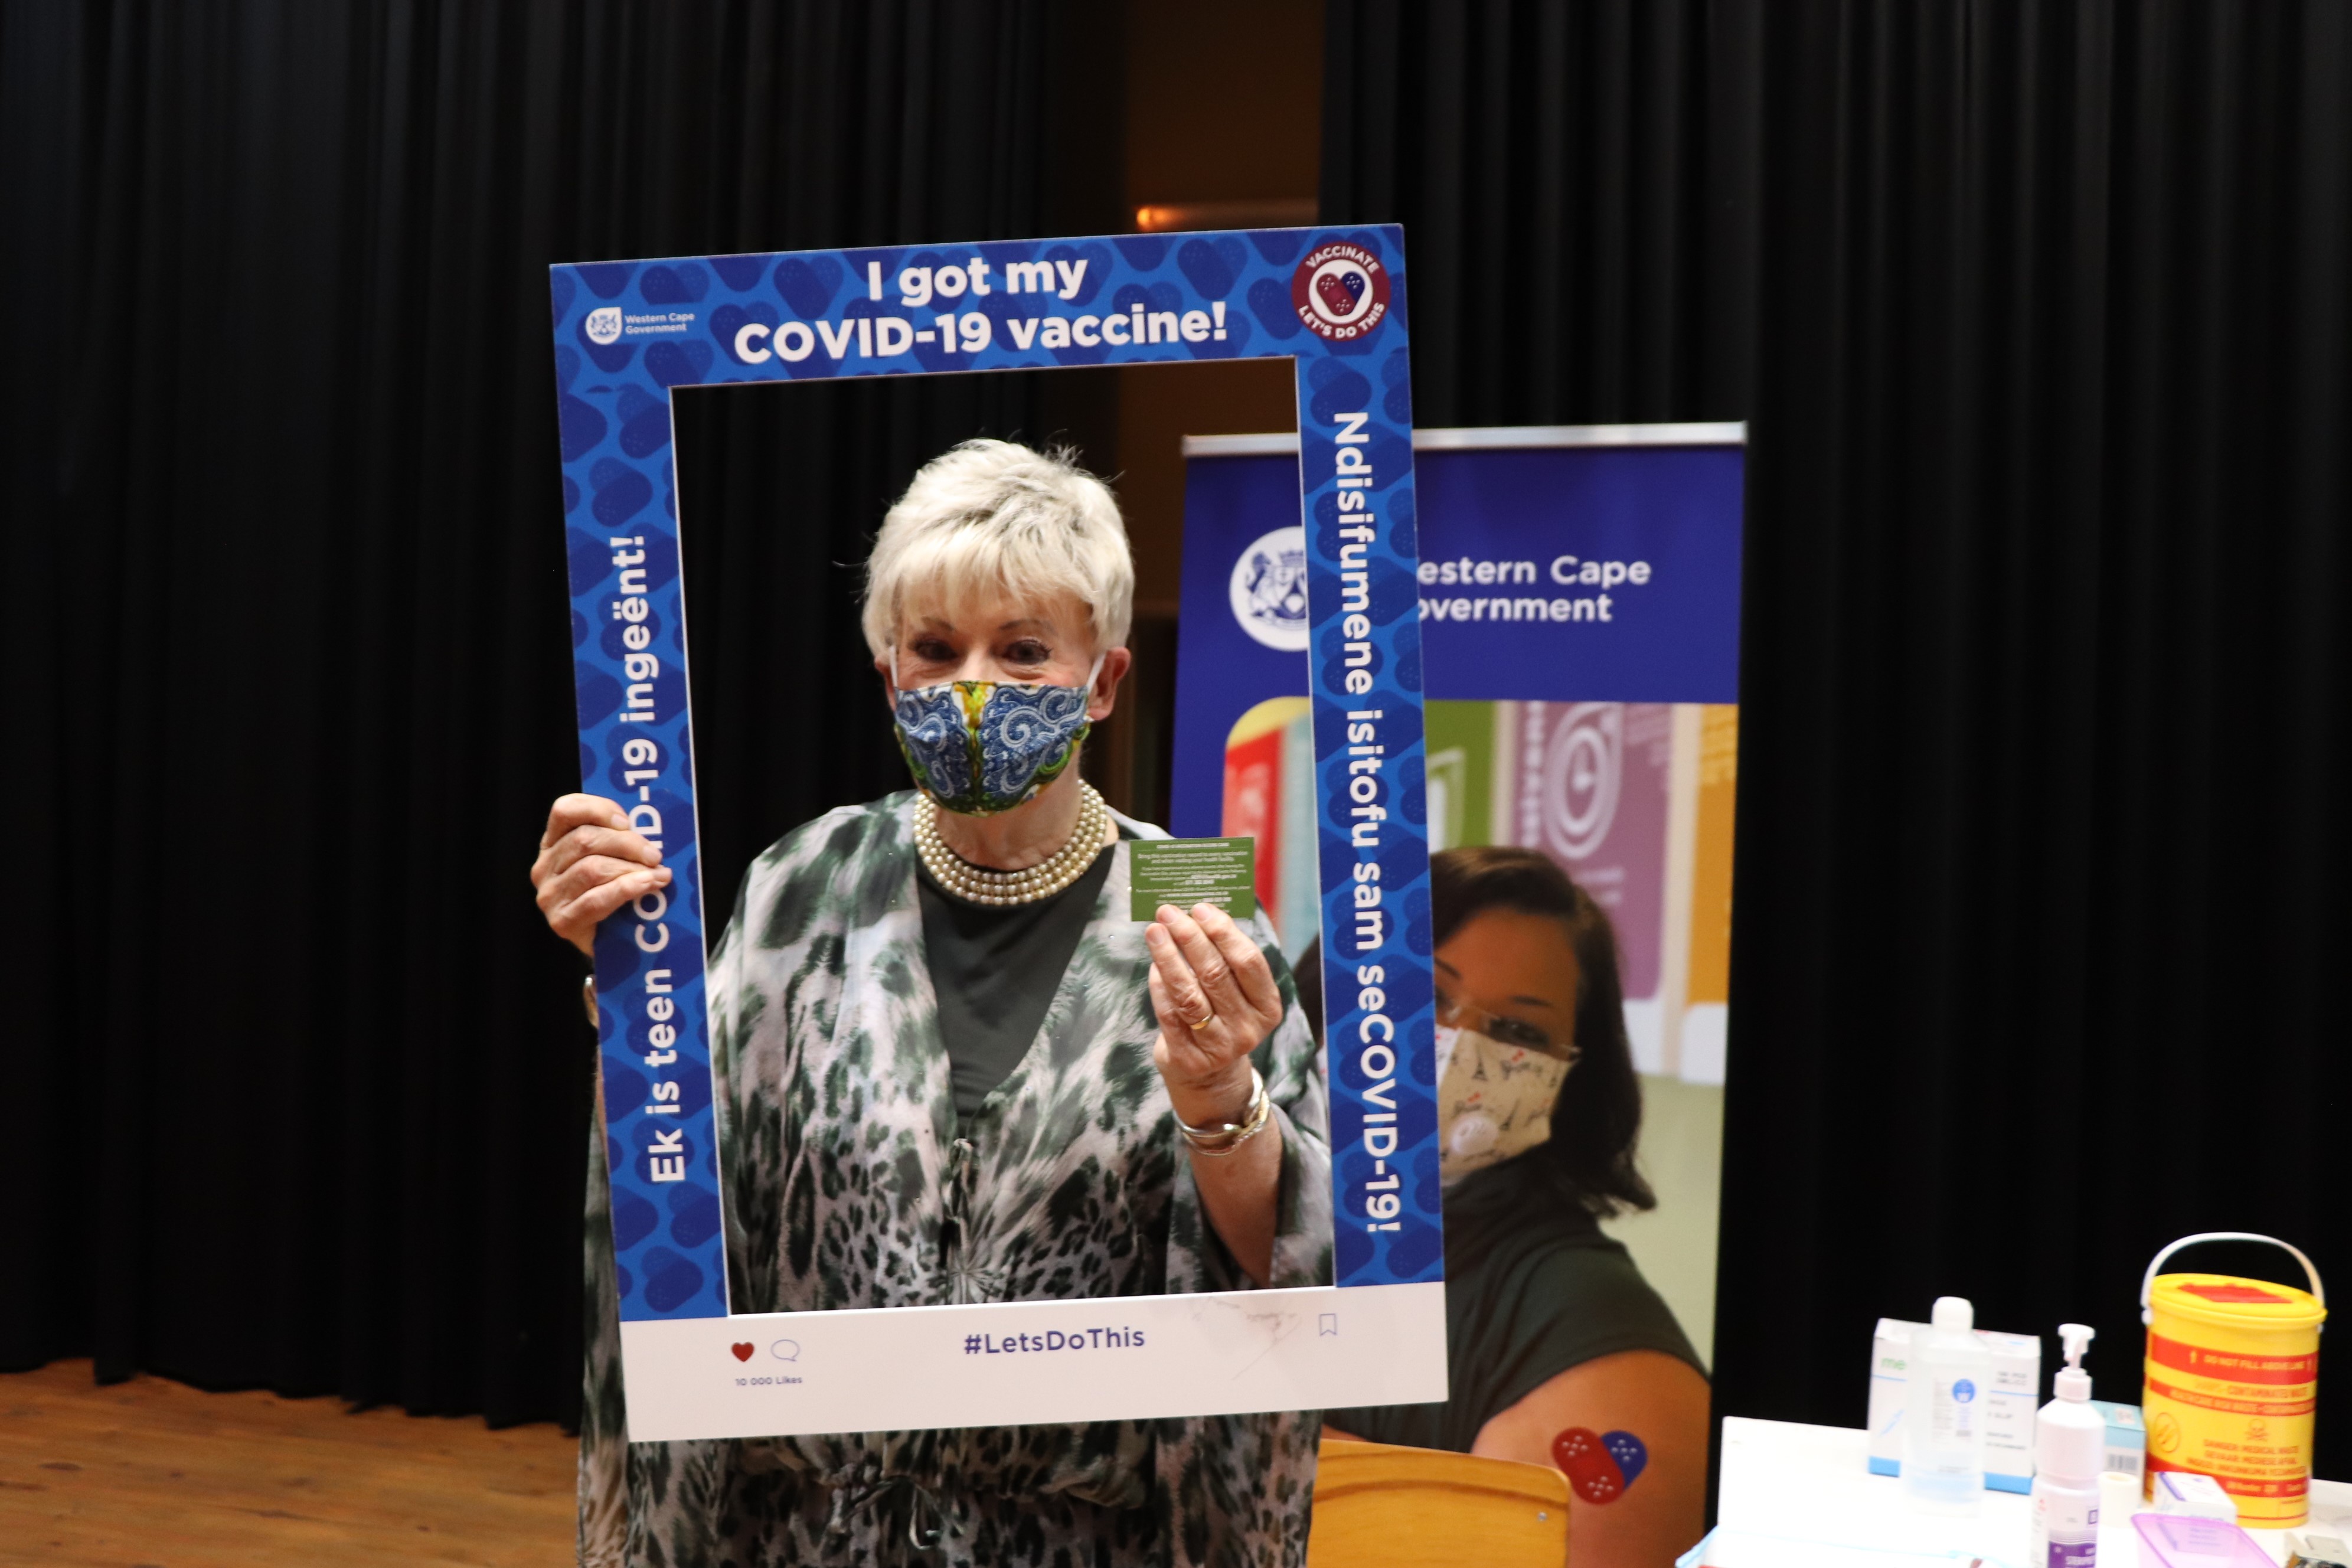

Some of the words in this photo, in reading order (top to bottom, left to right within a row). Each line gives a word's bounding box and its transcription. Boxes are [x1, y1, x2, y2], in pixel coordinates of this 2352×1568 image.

[868, 261, 883, 301] I
[898, 257, 991, 308] got
[1005, 259, 1088, 300] my
[1305, 246, 1380, 274] VACCINATE
[625, 315, 667, 324] Western
[668, 312, 695, 323] Cape
[625, 323, 687, 335] Government
[734, 312, 992, 364] COVID-19
[1007, 301, 1227, 351] vaccine!
[1299, 305, 1332, 337] LET'S
[1335, 326, 1357, 339] DO
[1358, 302, 1385, 331] THIS
[1334, 412, 1376, 695] Ndisifumene
[1418, 556, 1536, 585] estern
[1550, 554, 1652, 590] Cape
[610, 535, 655, 723] ingeënt!
[1419, 593, 1613, 622] overnment
[1347, 710, 1387, 847] isitofu
[622, 739, 669, 953] COD-19
[1353, 862, 1383, 950] sam
[644, 969, 677, 1067] teen
[645, 1081, 681, 1115] is
[1357, 965, 1401, 1233] seCOVID-19!
[648, 1128, 685, 1182] Ek
[964, 1326, 1145, 1354] #LetsDoThis
[735, 1378, 747, 1386] 10
[750, 1377, 773, 1386] 000
[776, 1376, 803, 1385] Likes
